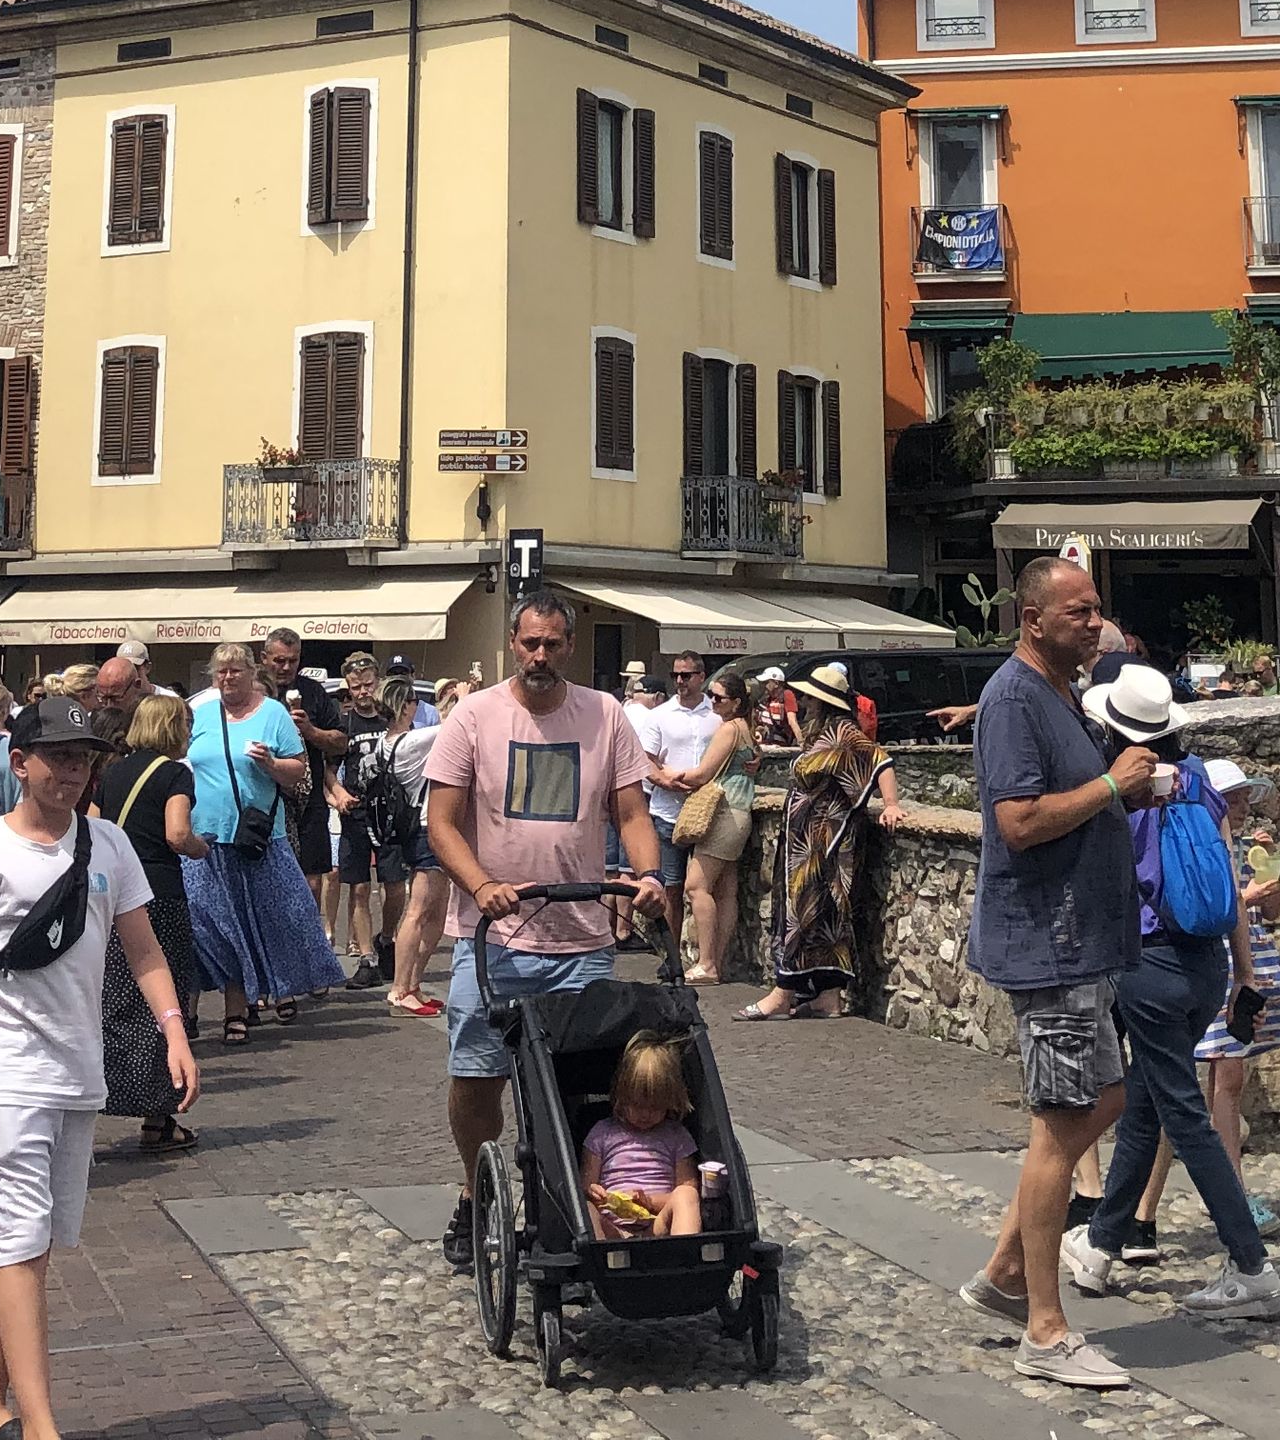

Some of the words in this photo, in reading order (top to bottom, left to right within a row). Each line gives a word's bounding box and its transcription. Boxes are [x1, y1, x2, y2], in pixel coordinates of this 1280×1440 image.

[440, 462, 463, 470] public
[513, 539, 538, 578] T
[49, 625, 127, 640] Tabaccheria
[156, 624, 222, 638] Ricevitoria
[250, 623, 271, 637] Bar
[303, 620, 369, 635] Gelateria
